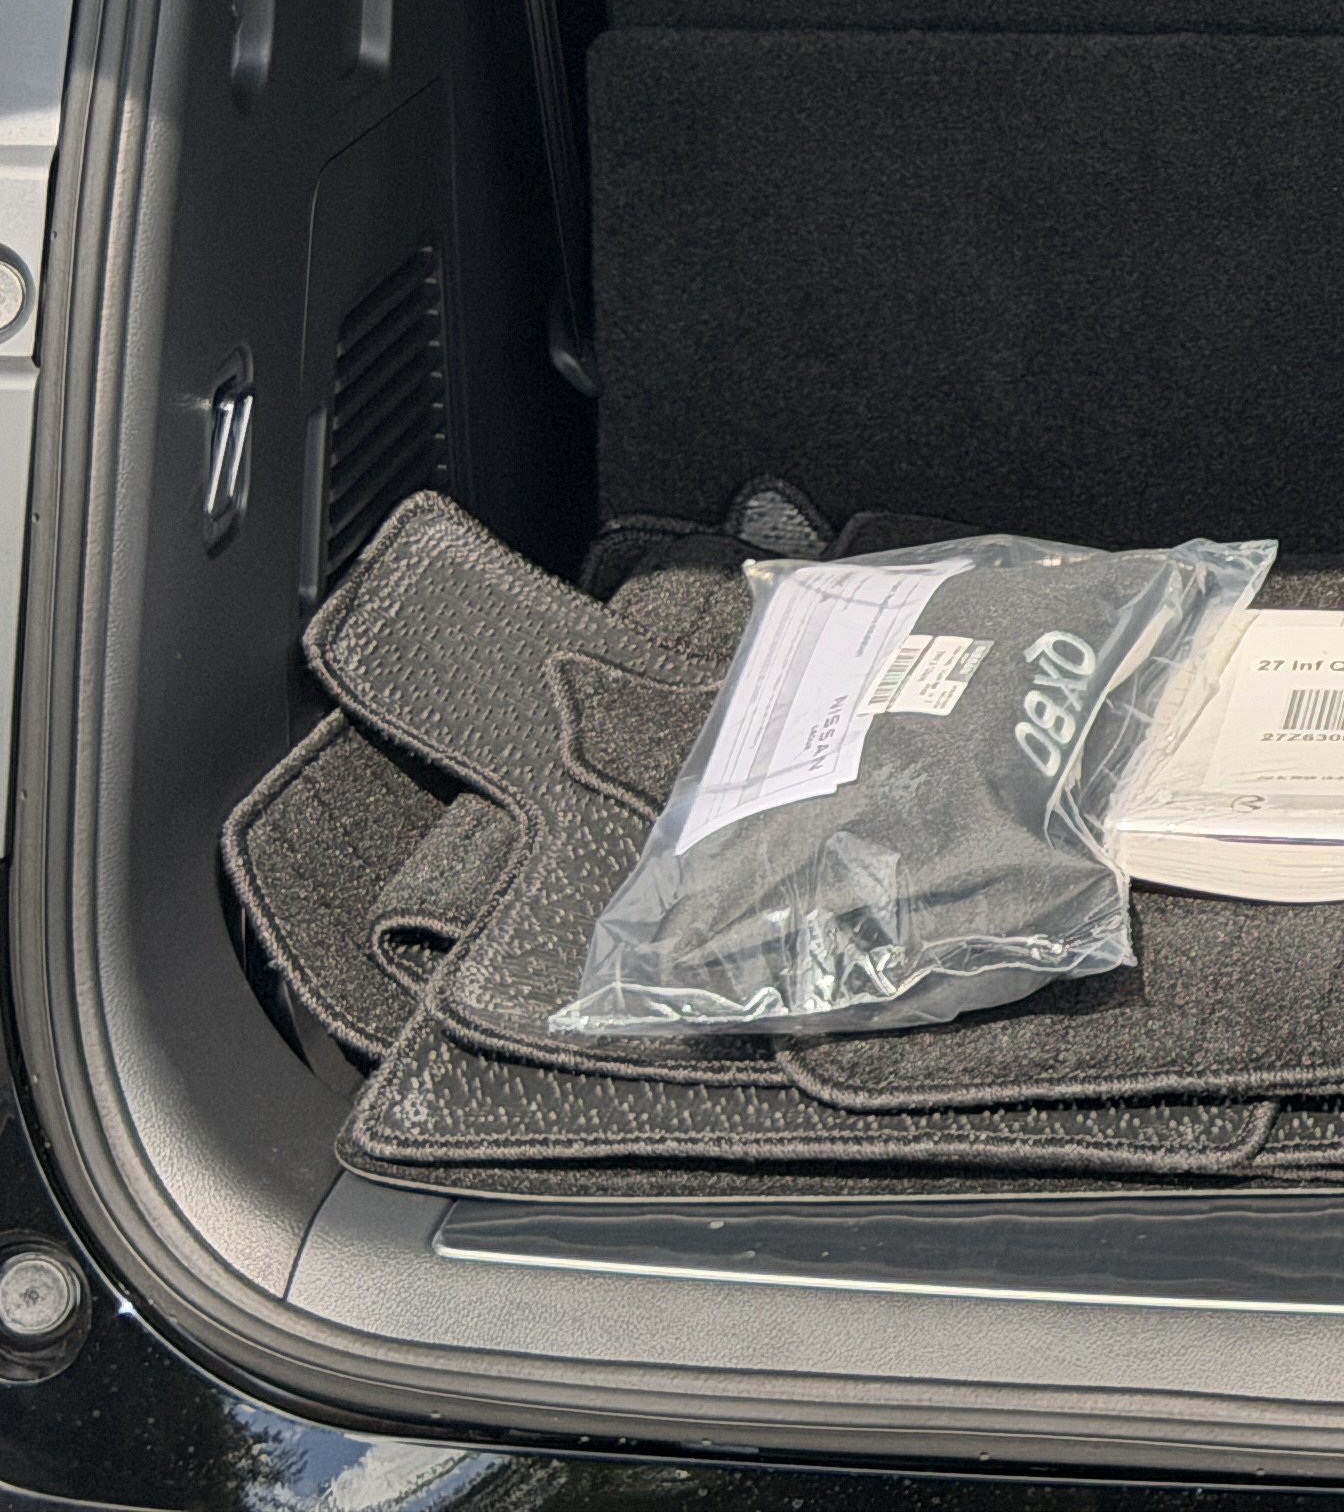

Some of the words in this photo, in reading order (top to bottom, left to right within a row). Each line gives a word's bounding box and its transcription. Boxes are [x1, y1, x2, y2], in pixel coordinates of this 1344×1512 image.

[1256, 659, 1286, 672] 27
[1291, 659, 1326, 672] Inf
[807, 694, 849, 772] NISSAN
